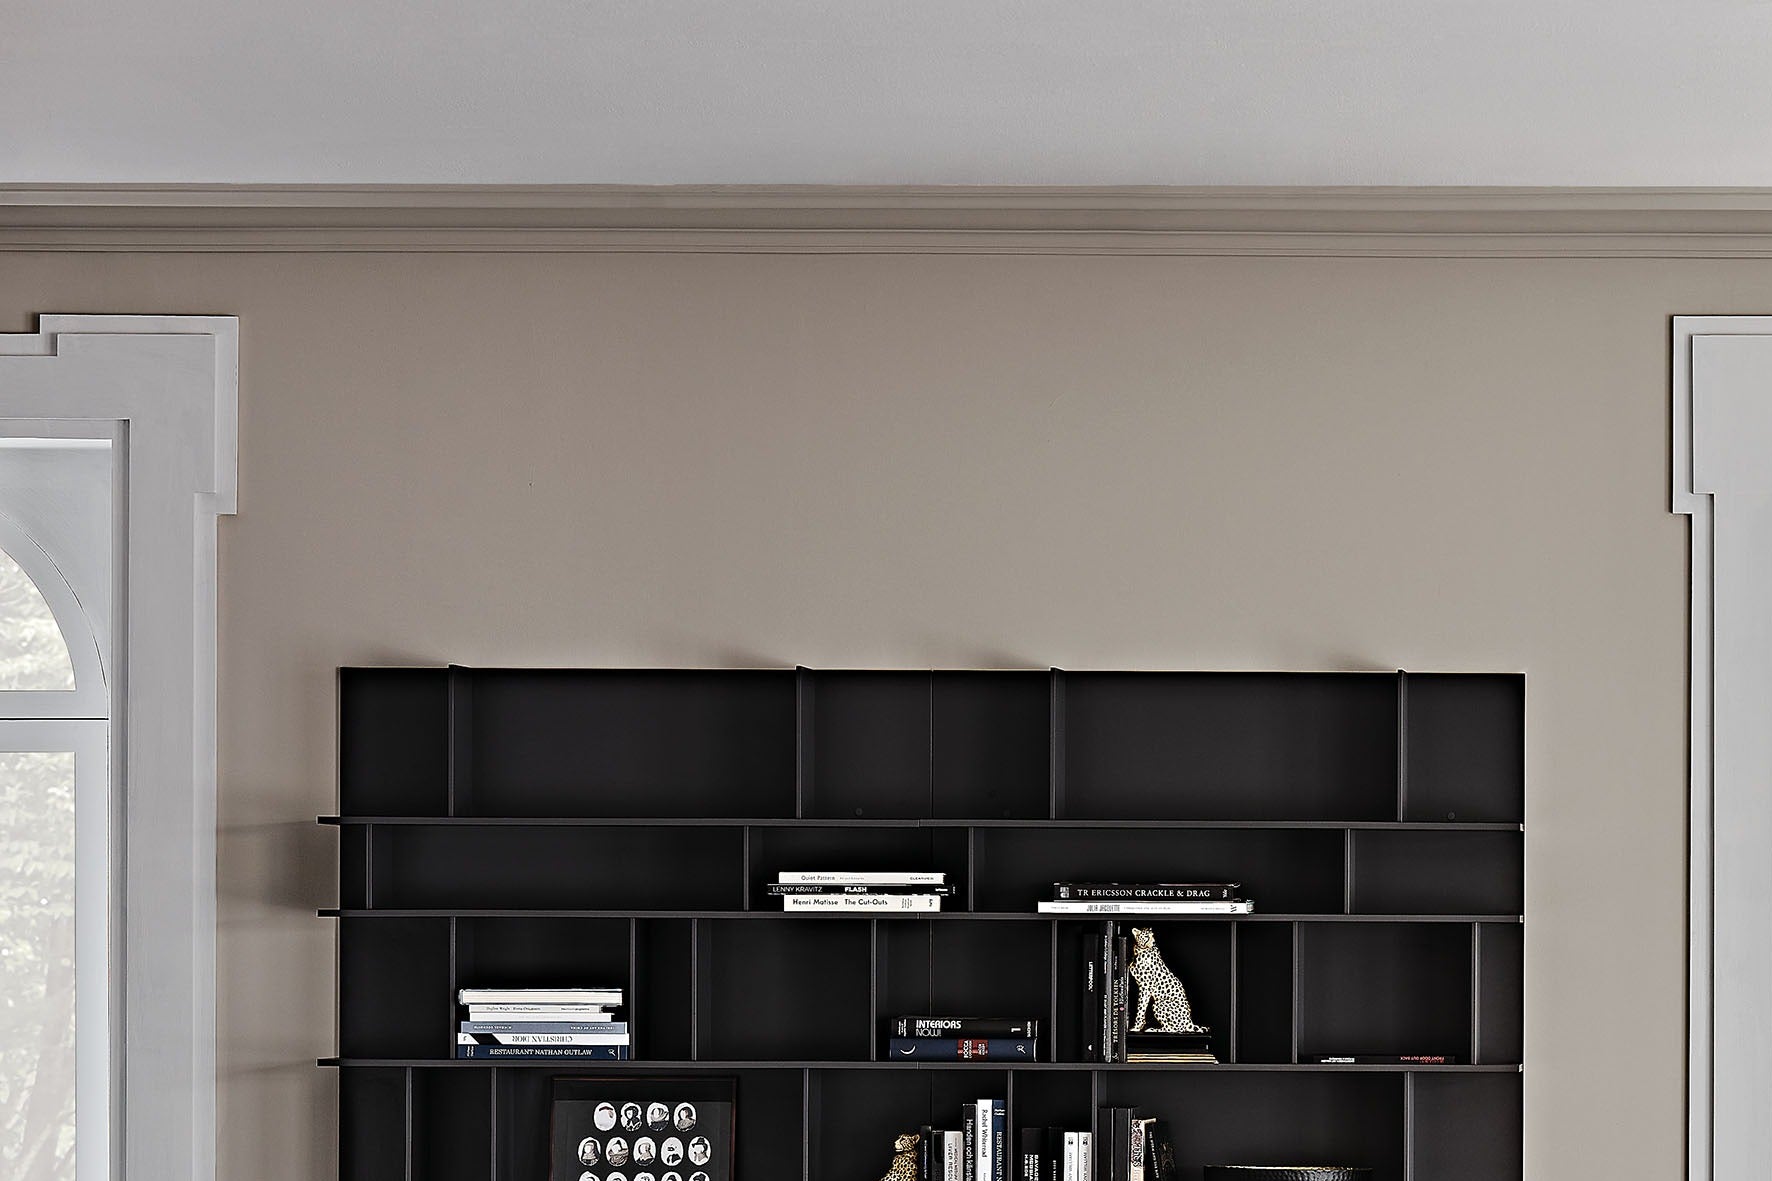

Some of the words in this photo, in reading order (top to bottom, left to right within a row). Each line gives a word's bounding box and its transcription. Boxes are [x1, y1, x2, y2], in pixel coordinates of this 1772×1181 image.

[1077, 889, 1089, 897] TR
[1091, 889, 1132, 897] ERICSSON
[1135, 889, 1174, 897] CRACKLE
[1176, 889, 1184, 897] &
[1186, 889, 1210, 897] DRAG
[916, 1020, 962, 1029] INTERIORS
